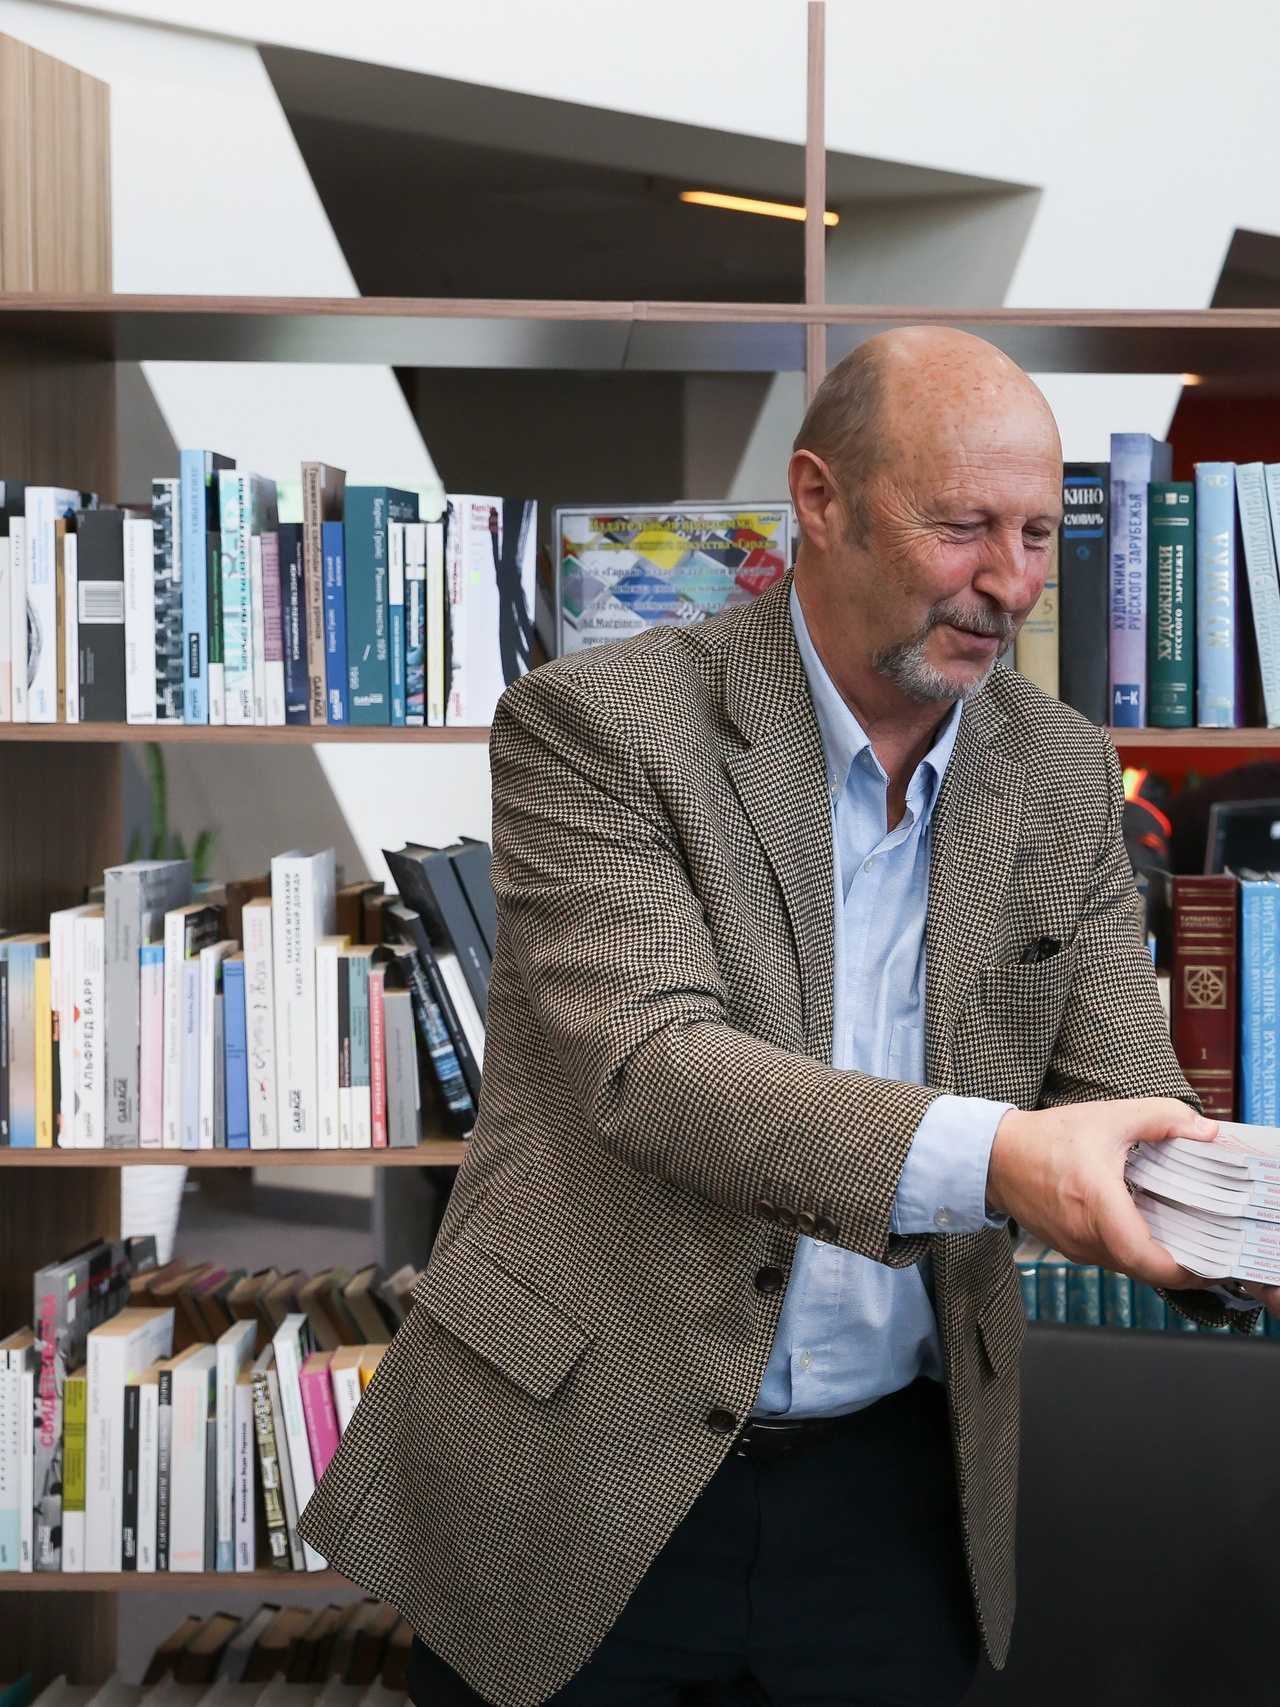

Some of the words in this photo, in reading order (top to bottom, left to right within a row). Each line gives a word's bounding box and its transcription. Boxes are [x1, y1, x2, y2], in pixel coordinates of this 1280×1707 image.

[374, 498, 386, 529] Борис
[1063, 488, 1105, 506] КИНО
[374, 530, 386, 560] Гройс
[1127, 493, 1143, 564] ЗАРУБЕЖЬЯ
[375, 567, 386, 603] Ранние
[1113, 553, 1126, 631] ХУДОЖНИКИ
[1174, 545, 1184, 603] ЗАРУБЕЖЬЯ
[1204, 532, 1231, 648] МУЗЫКА
[1127, 571, 1142, 631] РУССКОГО
[1157, 545, 1174, 661] ХУДОЖНИКИ
[375, 604, 385, 637] тексты
[1174, 608, 1184, 661] РУССКОГО
[313, 676, 323, 719] GARAGE
[1262, 895, 1277, 1023] ЭНЦИКЛОПЕДИЯ
[83, 979, 94, 1014] БАРР
[83, 1021, 94, 1090] АЛЬФРЕД
[1200, 1048, 1208, 1060] 1
[116, 1079, 128, 1124] GARAGE
[292, 1090, 302, 1133] GARAGE
[1259, 1161, 1278, 1170] ТЕРЕМЕ
[1257, 1211, 1275, 1219] ТЕРЕМЕ
[1263, 1199, 1280, 1207] ТЕРЕМЕ
[1255, 1223, 1273, 1231] ТЕРЕМЕ
[1253, 1260, 1272, 1268] ТЕРЕМЕ
[1257, 1248, 1275, 1256] ТЕРЕМЕ
[1246, 1272, 1264, 1280] ТЕРЕМЕ
[40, 1294, 57, 1448] СВИДЕТЕЛЬСТВА
